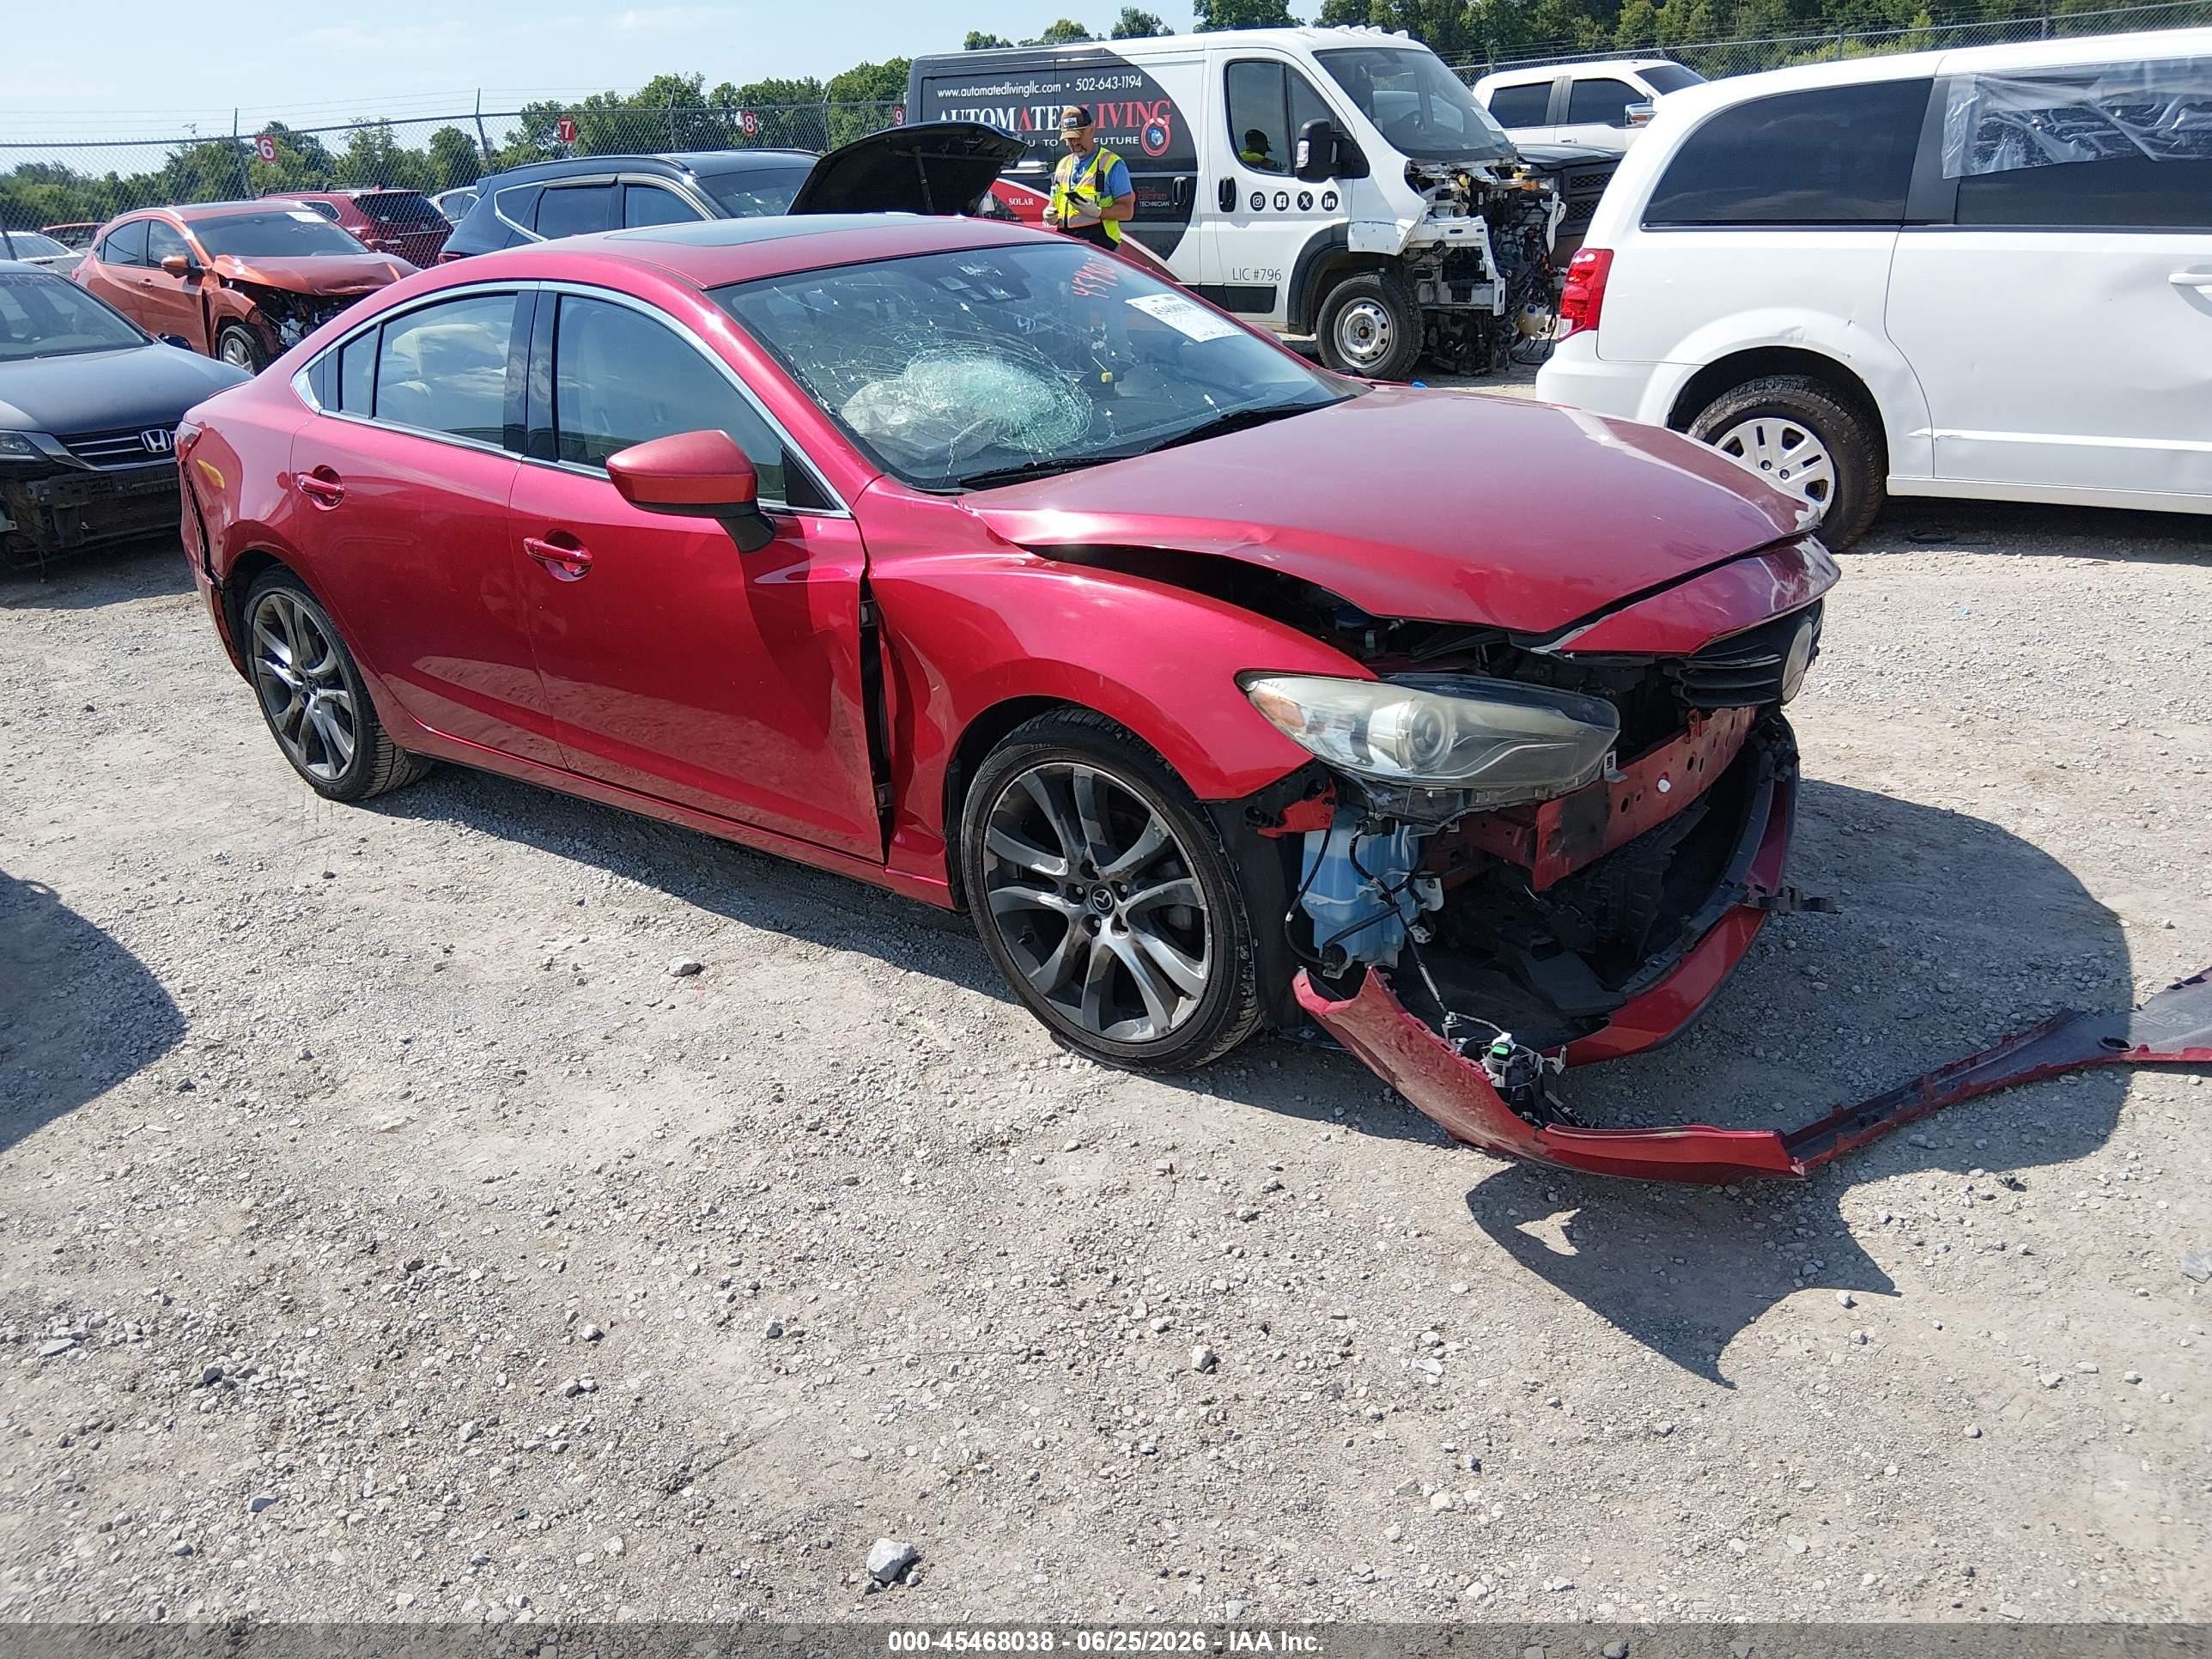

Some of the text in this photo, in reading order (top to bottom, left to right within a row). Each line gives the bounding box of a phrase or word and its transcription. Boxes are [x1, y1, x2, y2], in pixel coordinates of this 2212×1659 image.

[937, 80, 1060, 98] www.automatedlivingllc.com
[1075, 75, 1142, 92] 502-643-1194
[744, 115, 755, 132] 8
[896, 110, 903, 126] 9
[560, 120, 571, 139] 7
[260, 139, 275, 159] 6
[1008, 198, 1035, 206] SOLAR
[1232, 267, 1282, 281] LIC #796
